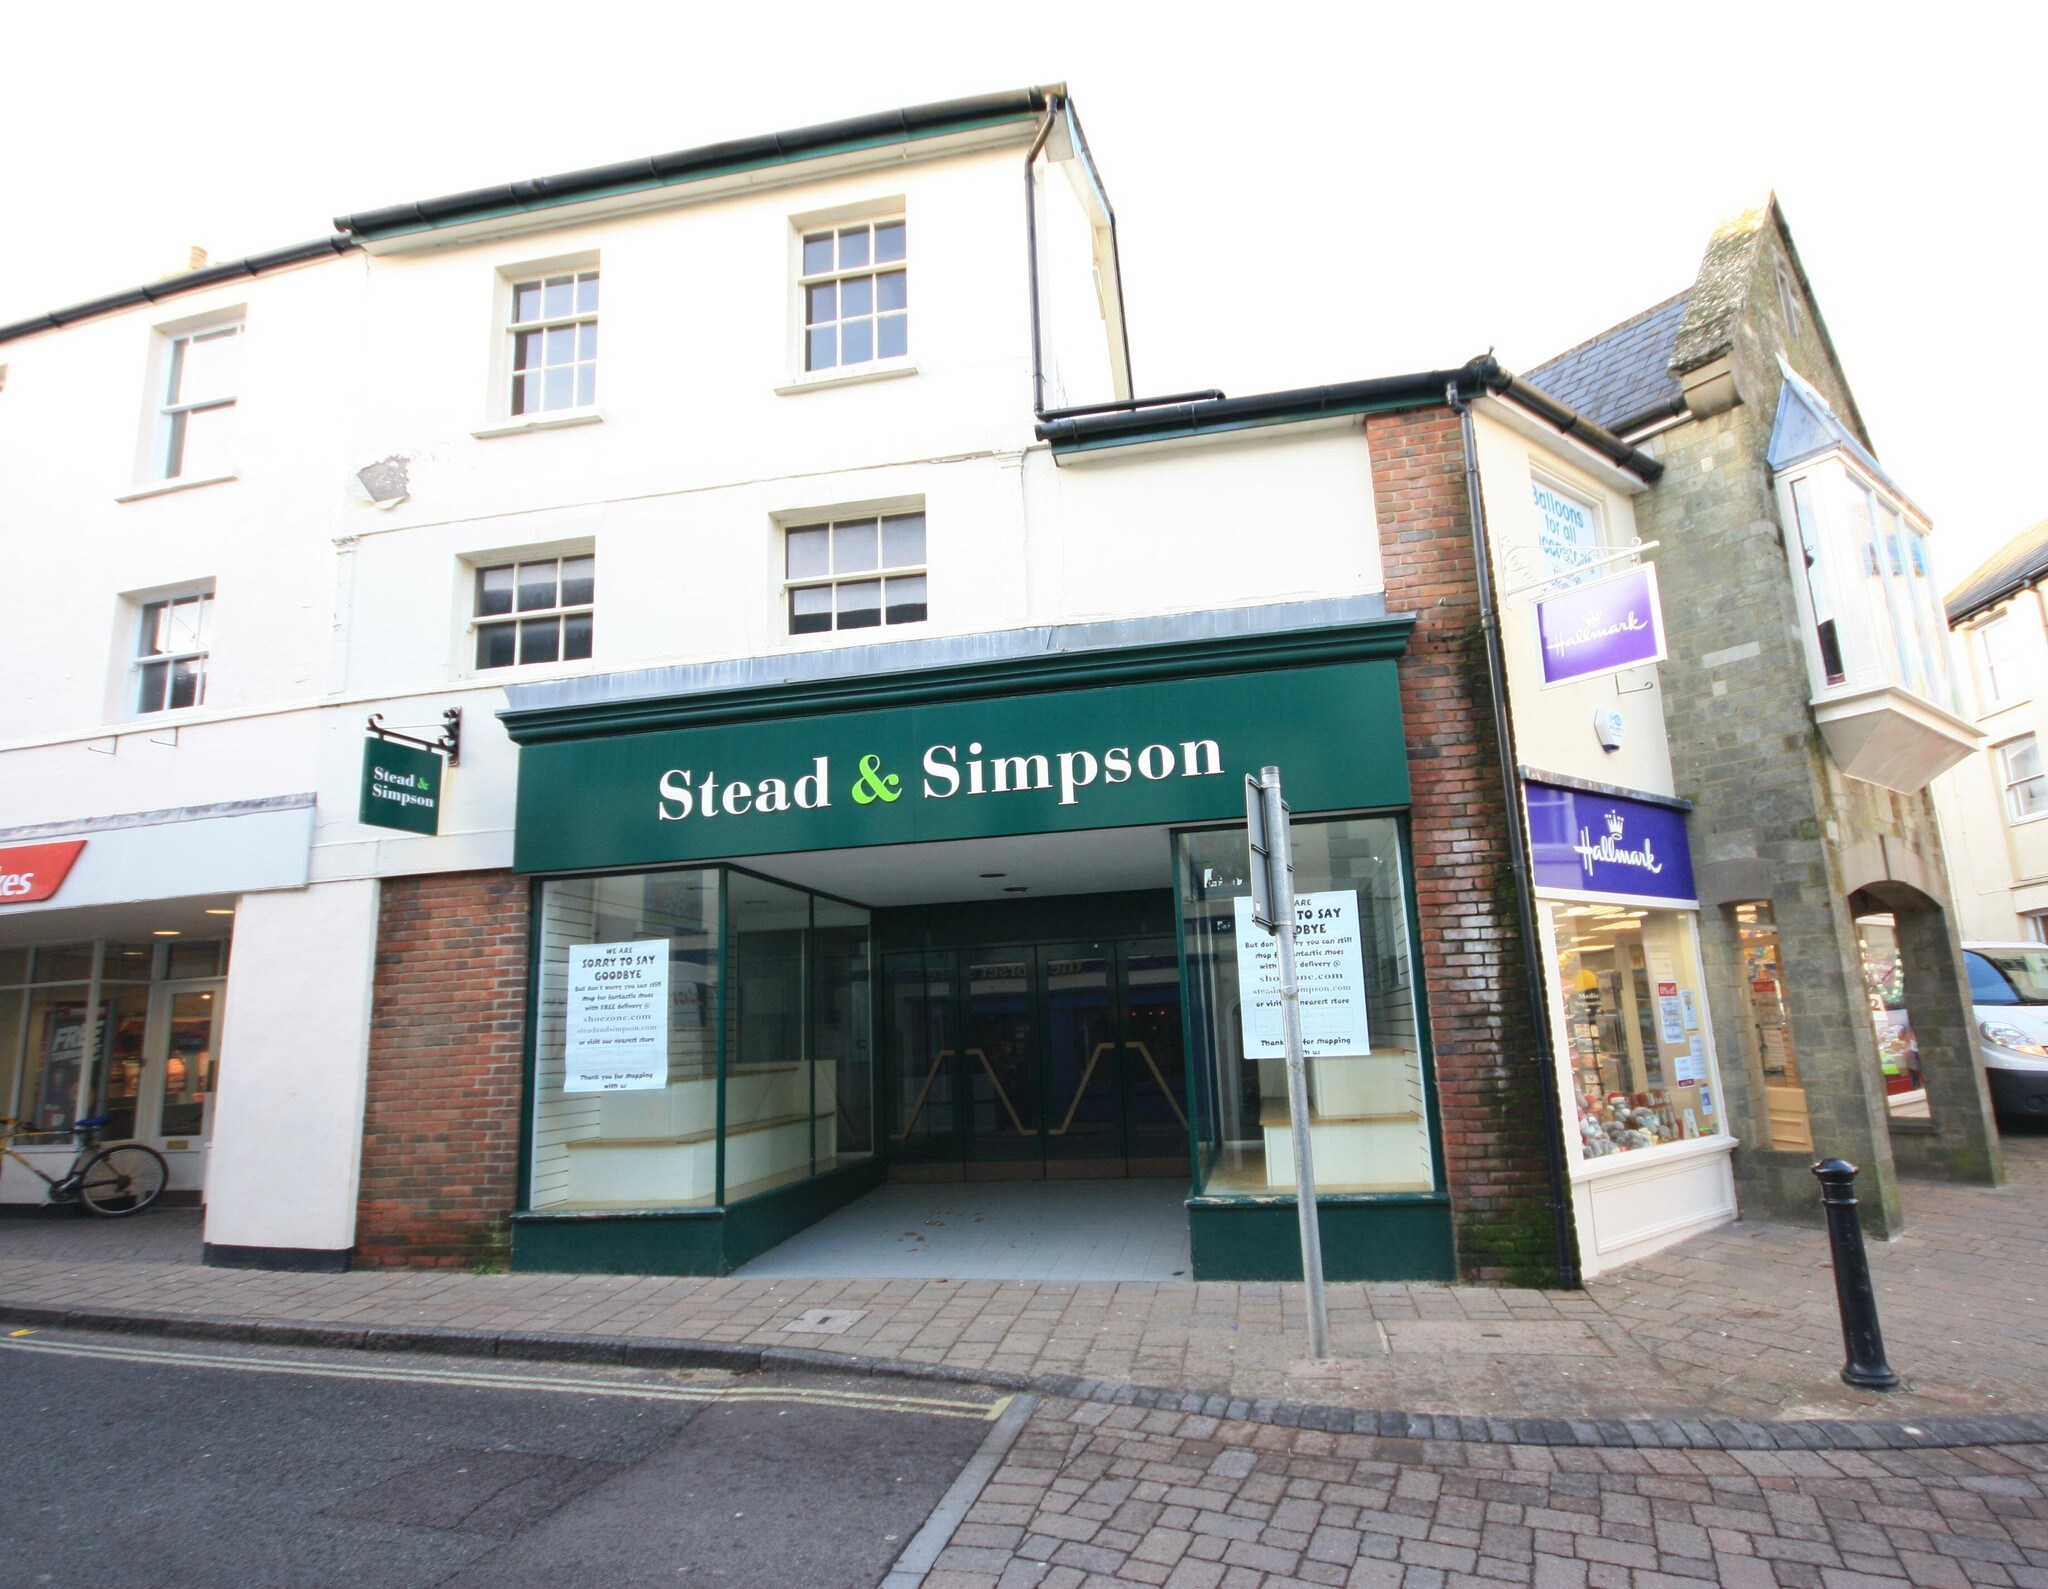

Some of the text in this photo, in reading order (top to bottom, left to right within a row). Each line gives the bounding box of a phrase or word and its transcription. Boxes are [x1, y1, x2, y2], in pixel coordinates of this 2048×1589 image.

[1545, 513, 1577, 545] for all
[1546, 611, 1649, 658] Hallmark
[373, 766, 430, 790] Stead &
[658, 737, 1226, 821] Stead & Simpson
[372, 782, 434, 808] Simpson
[1573, 825, 1663, 877] Hallmark
[1297, 908, 1342, 920] TO SAY
[1306, 939, 1320, 947] you
[1337, 936, 1352, 944] still
[606, 947, 617, 955] WE
[582, 955, 656, 968] SORRY TO SAY
[1260, 962, 1277, 970] with
[1300, 960, 1331, 968] delivery
[595, 970, 642, 981] GOODBYE
[1299, 998, 1329, 1006] nearest
[583, 1014, 652, 1023] shoezone.com
[577, 1024, 657, 1034] steadandsimpson.com
[580, 1073, 599, 1081] Thank
[601, 1073, 613, 1081] you
